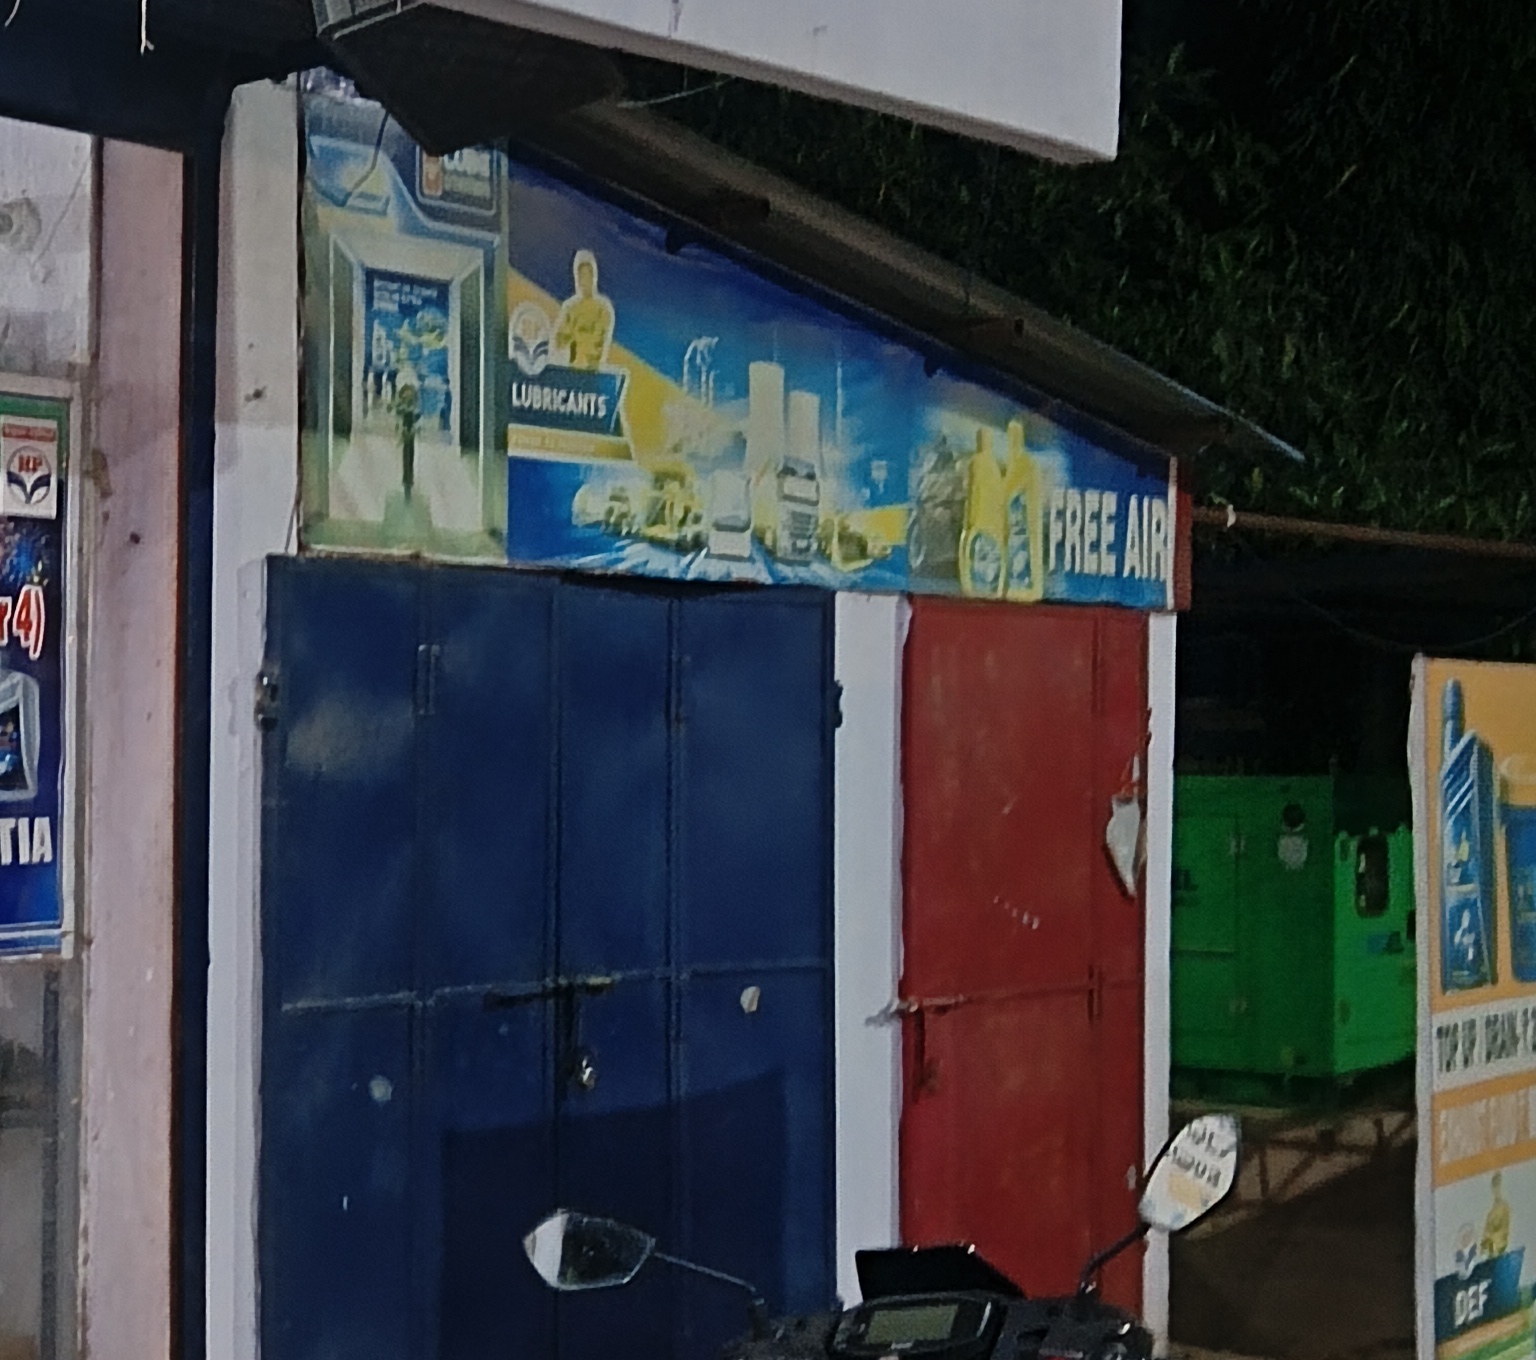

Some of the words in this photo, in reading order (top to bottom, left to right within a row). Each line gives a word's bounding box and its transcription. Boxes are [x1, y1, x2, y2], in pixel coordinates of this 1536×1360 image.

[512, 382, 610, 419] LUBRICANTS
[1049, 489, 1118, 578] FREE
[1124, 494, 1168, 581] AIR
[12, 585, 45, 659] 4)
[1453, 1280, 1489, 1328] DEF
